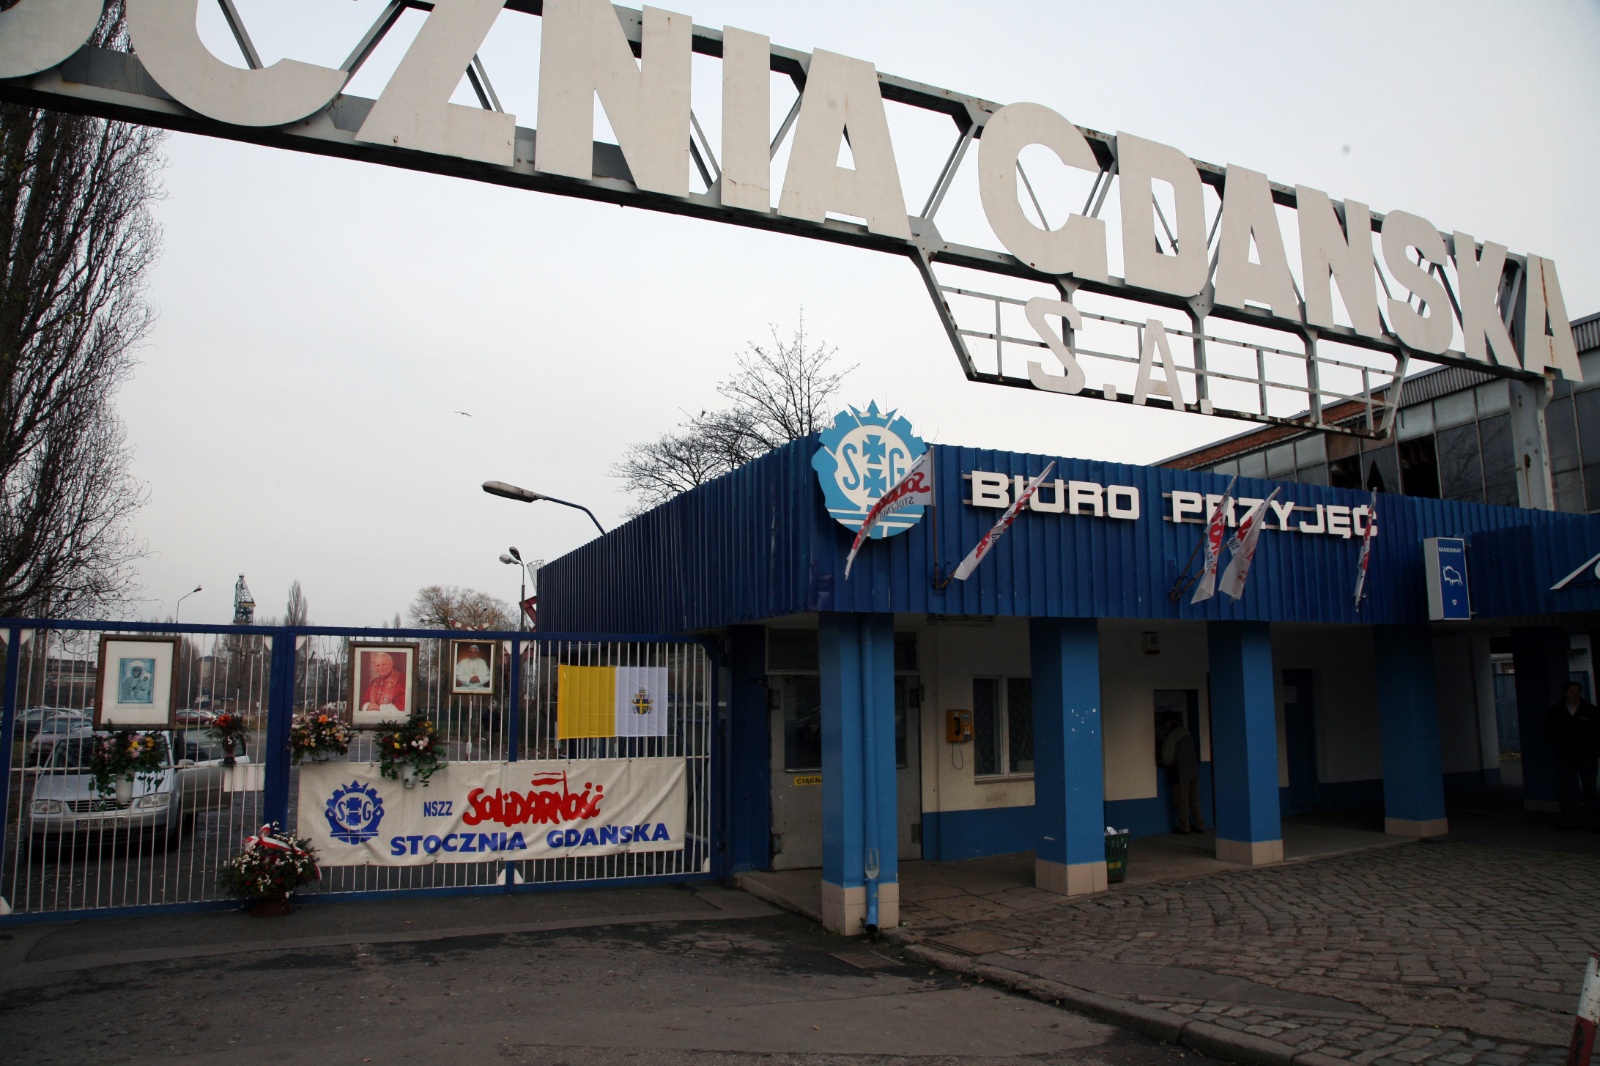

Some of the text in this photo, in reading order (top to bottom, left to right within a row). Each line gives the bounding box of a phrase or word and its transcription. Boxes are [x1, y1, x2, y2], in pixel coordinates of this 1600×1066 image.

[0, 0, 1583, 382] CZNIA GDANSKA
[1025, 297, 1212, 414] S.A.
[971, 470, 1140, 520] BIURO
[1171, 490, 1378, 539] PRZYJĘĆ
[797, 777, 822, 785] CIĄGN
[423, 801, 453, 817] NSZZ
[390, 822, 671, 856] STOCZNIA GDAŃSKA
